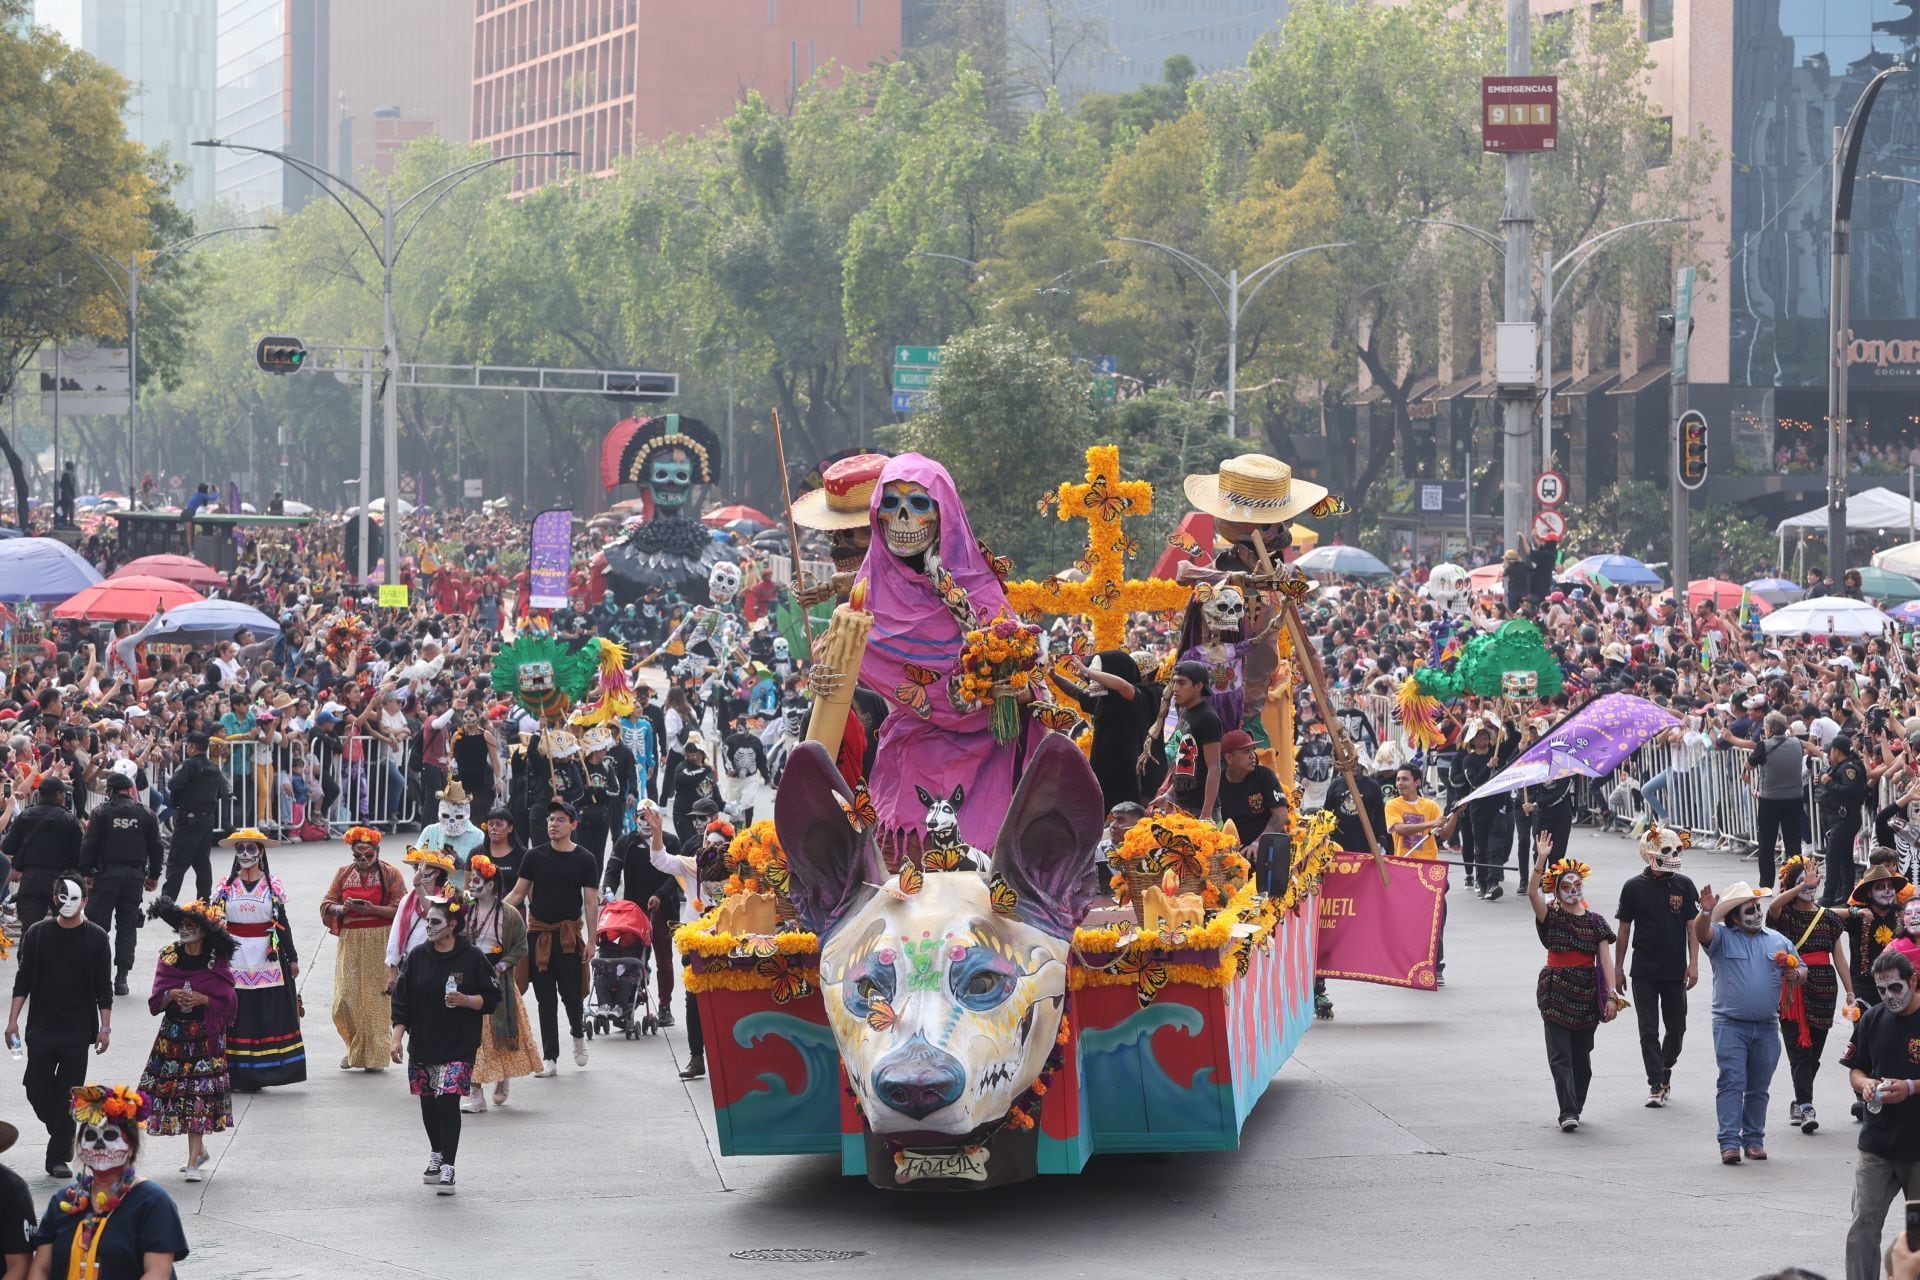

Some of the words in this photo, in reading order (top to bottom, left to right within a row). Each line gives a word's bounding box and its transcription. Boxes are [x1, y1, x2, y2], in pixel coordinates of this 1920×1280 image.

[1488, 85, 1553, 93] EMERGENCIAS
[1492, 107, 1545, 123] 911
[1875, 368, 1911, 376] COCINA
[113, 817, 138, 829] SSC
